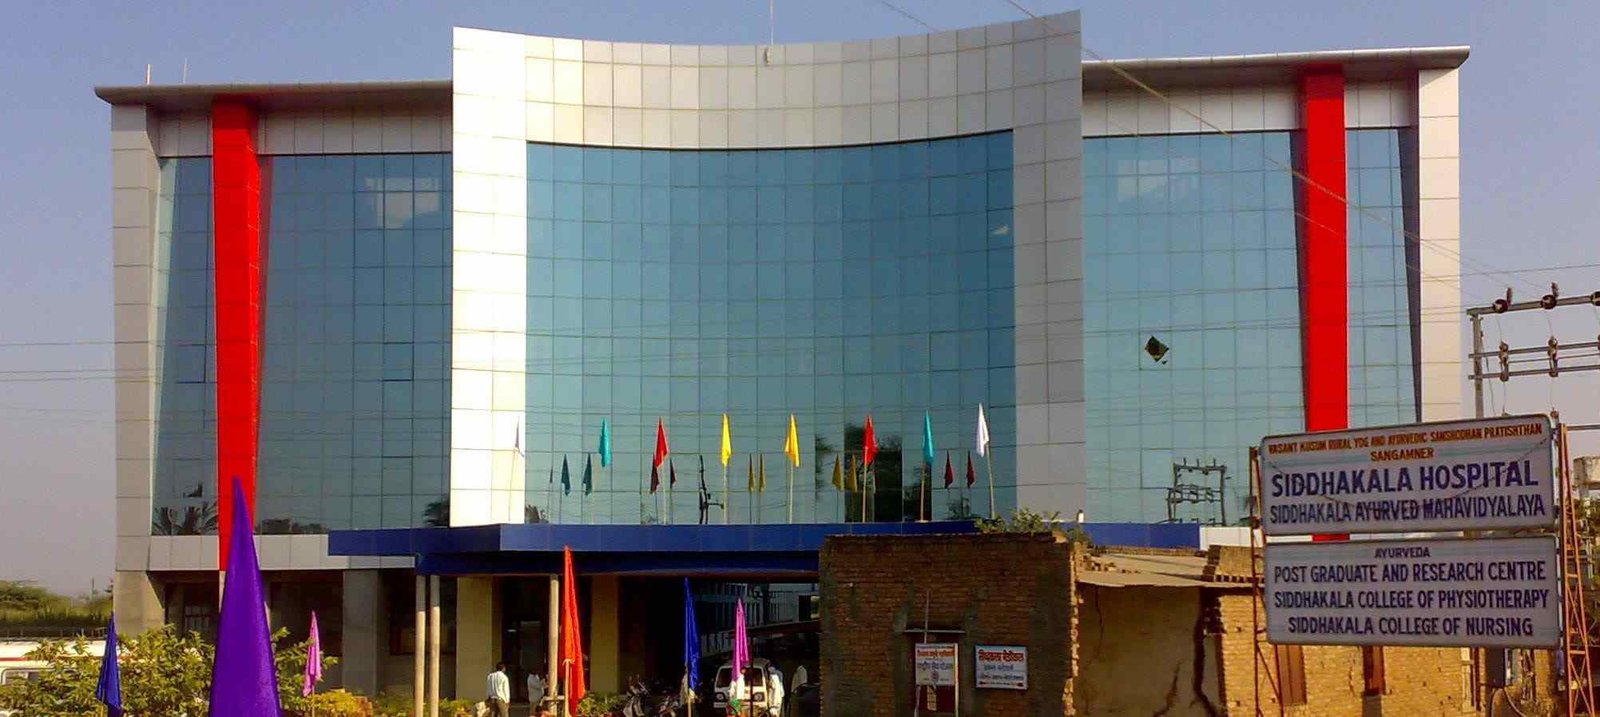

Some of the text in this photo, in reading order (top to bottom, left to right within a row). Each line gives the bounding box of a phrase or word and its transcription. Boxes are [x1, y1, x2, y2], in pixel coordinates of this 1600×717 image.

[1484, 423, 1543, 439] PRATISHTHAN
[1371, 447, 1434, 461] SANGAMNER
[1271, 460, 1539, 497] SIDDHAKALA HOSPITAL
[1270, 494, 1545, 524] SIDDHAKALA AYURVED MAHAVIDYALAYA
[1374, 547, 1430, 558] AYURVEDA
[1274, 560, 1546, 583] POST GRADUATE AND RESEARCH CENTRE
[1274, 588, 1549, 608] SIDDHAKALA COLLEGE OF PHYSIOTHERAPY
[1288, 616, 1533, 636] SIDDHAKALA COLLEGE OF NURSING
